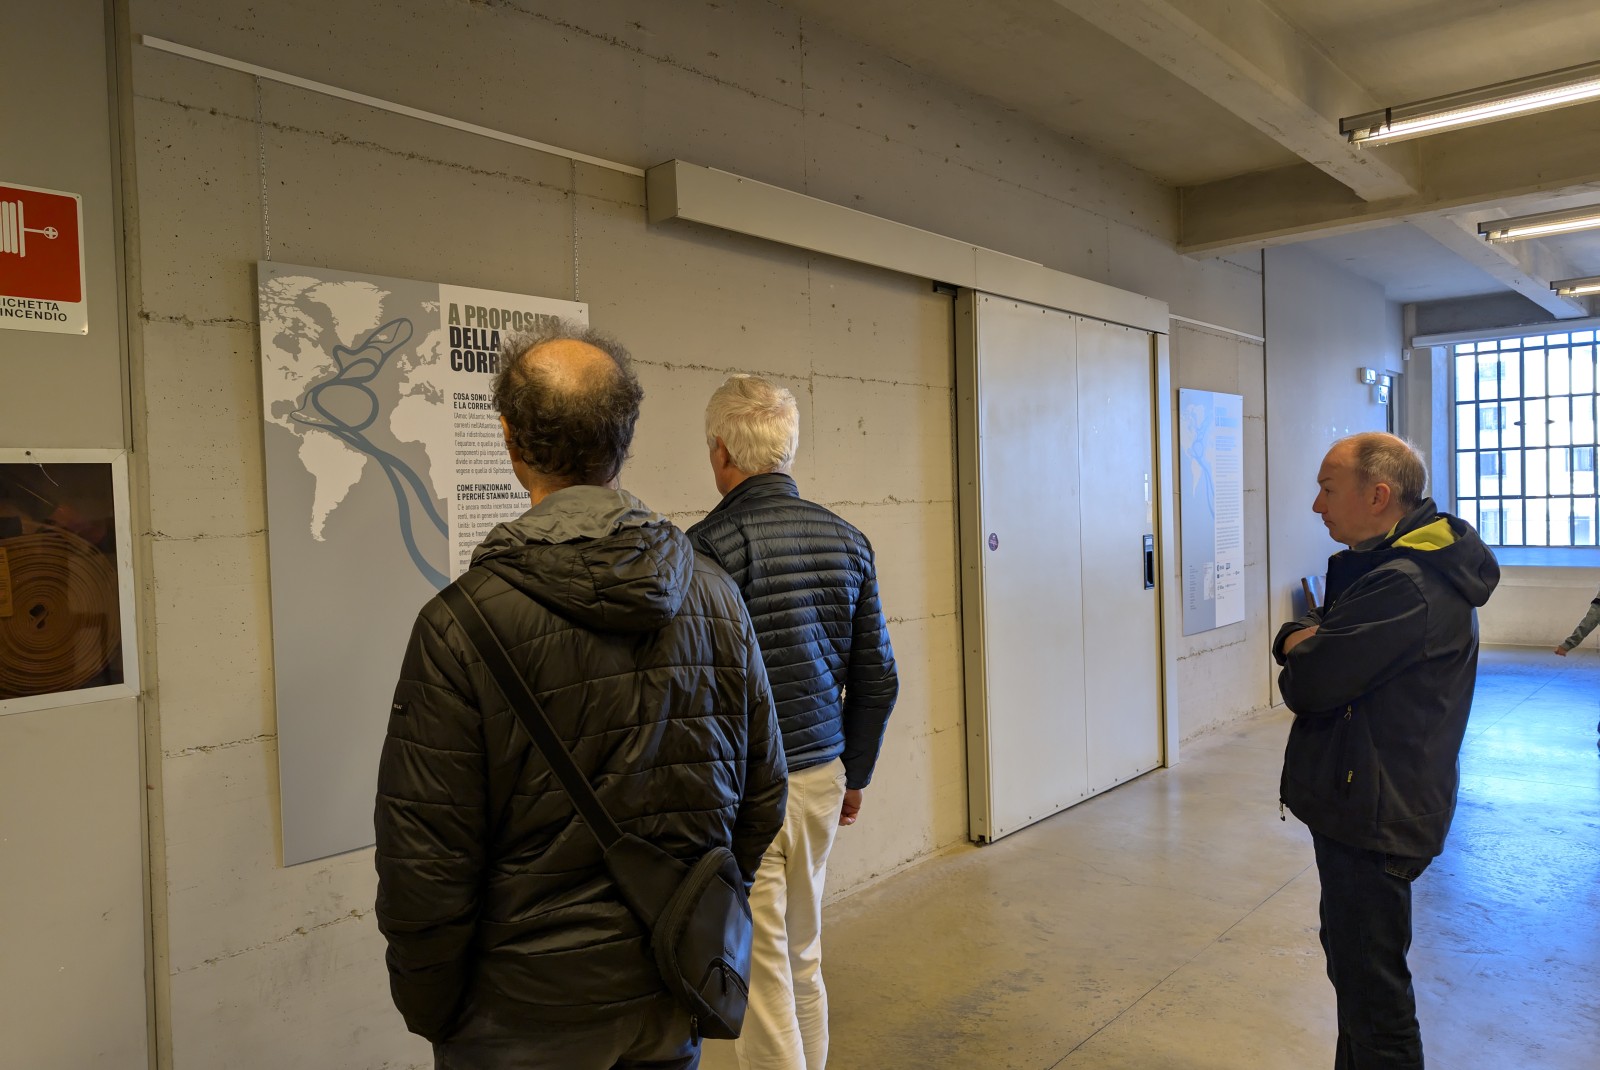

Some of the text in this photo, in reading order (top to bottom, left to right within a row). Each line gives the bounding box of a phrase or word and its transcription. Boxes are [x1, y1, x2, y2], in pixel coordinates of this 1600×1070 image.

[0, 297, 60, 312] ICHETTA
[448, 302, 461, 326] A
[449, 325, 501, 352] DELLA
[450, 349, 501, 375] CORR
[453, 392, 469, 401] COSA
[470, 393, 486, 402] SONO
[453, 401, 458, 409] E
[456, 483, 512, 492] COME FUNZIONANO
[457, 492, 462, 501] E
[485, 492, 510, 500] STANNO
